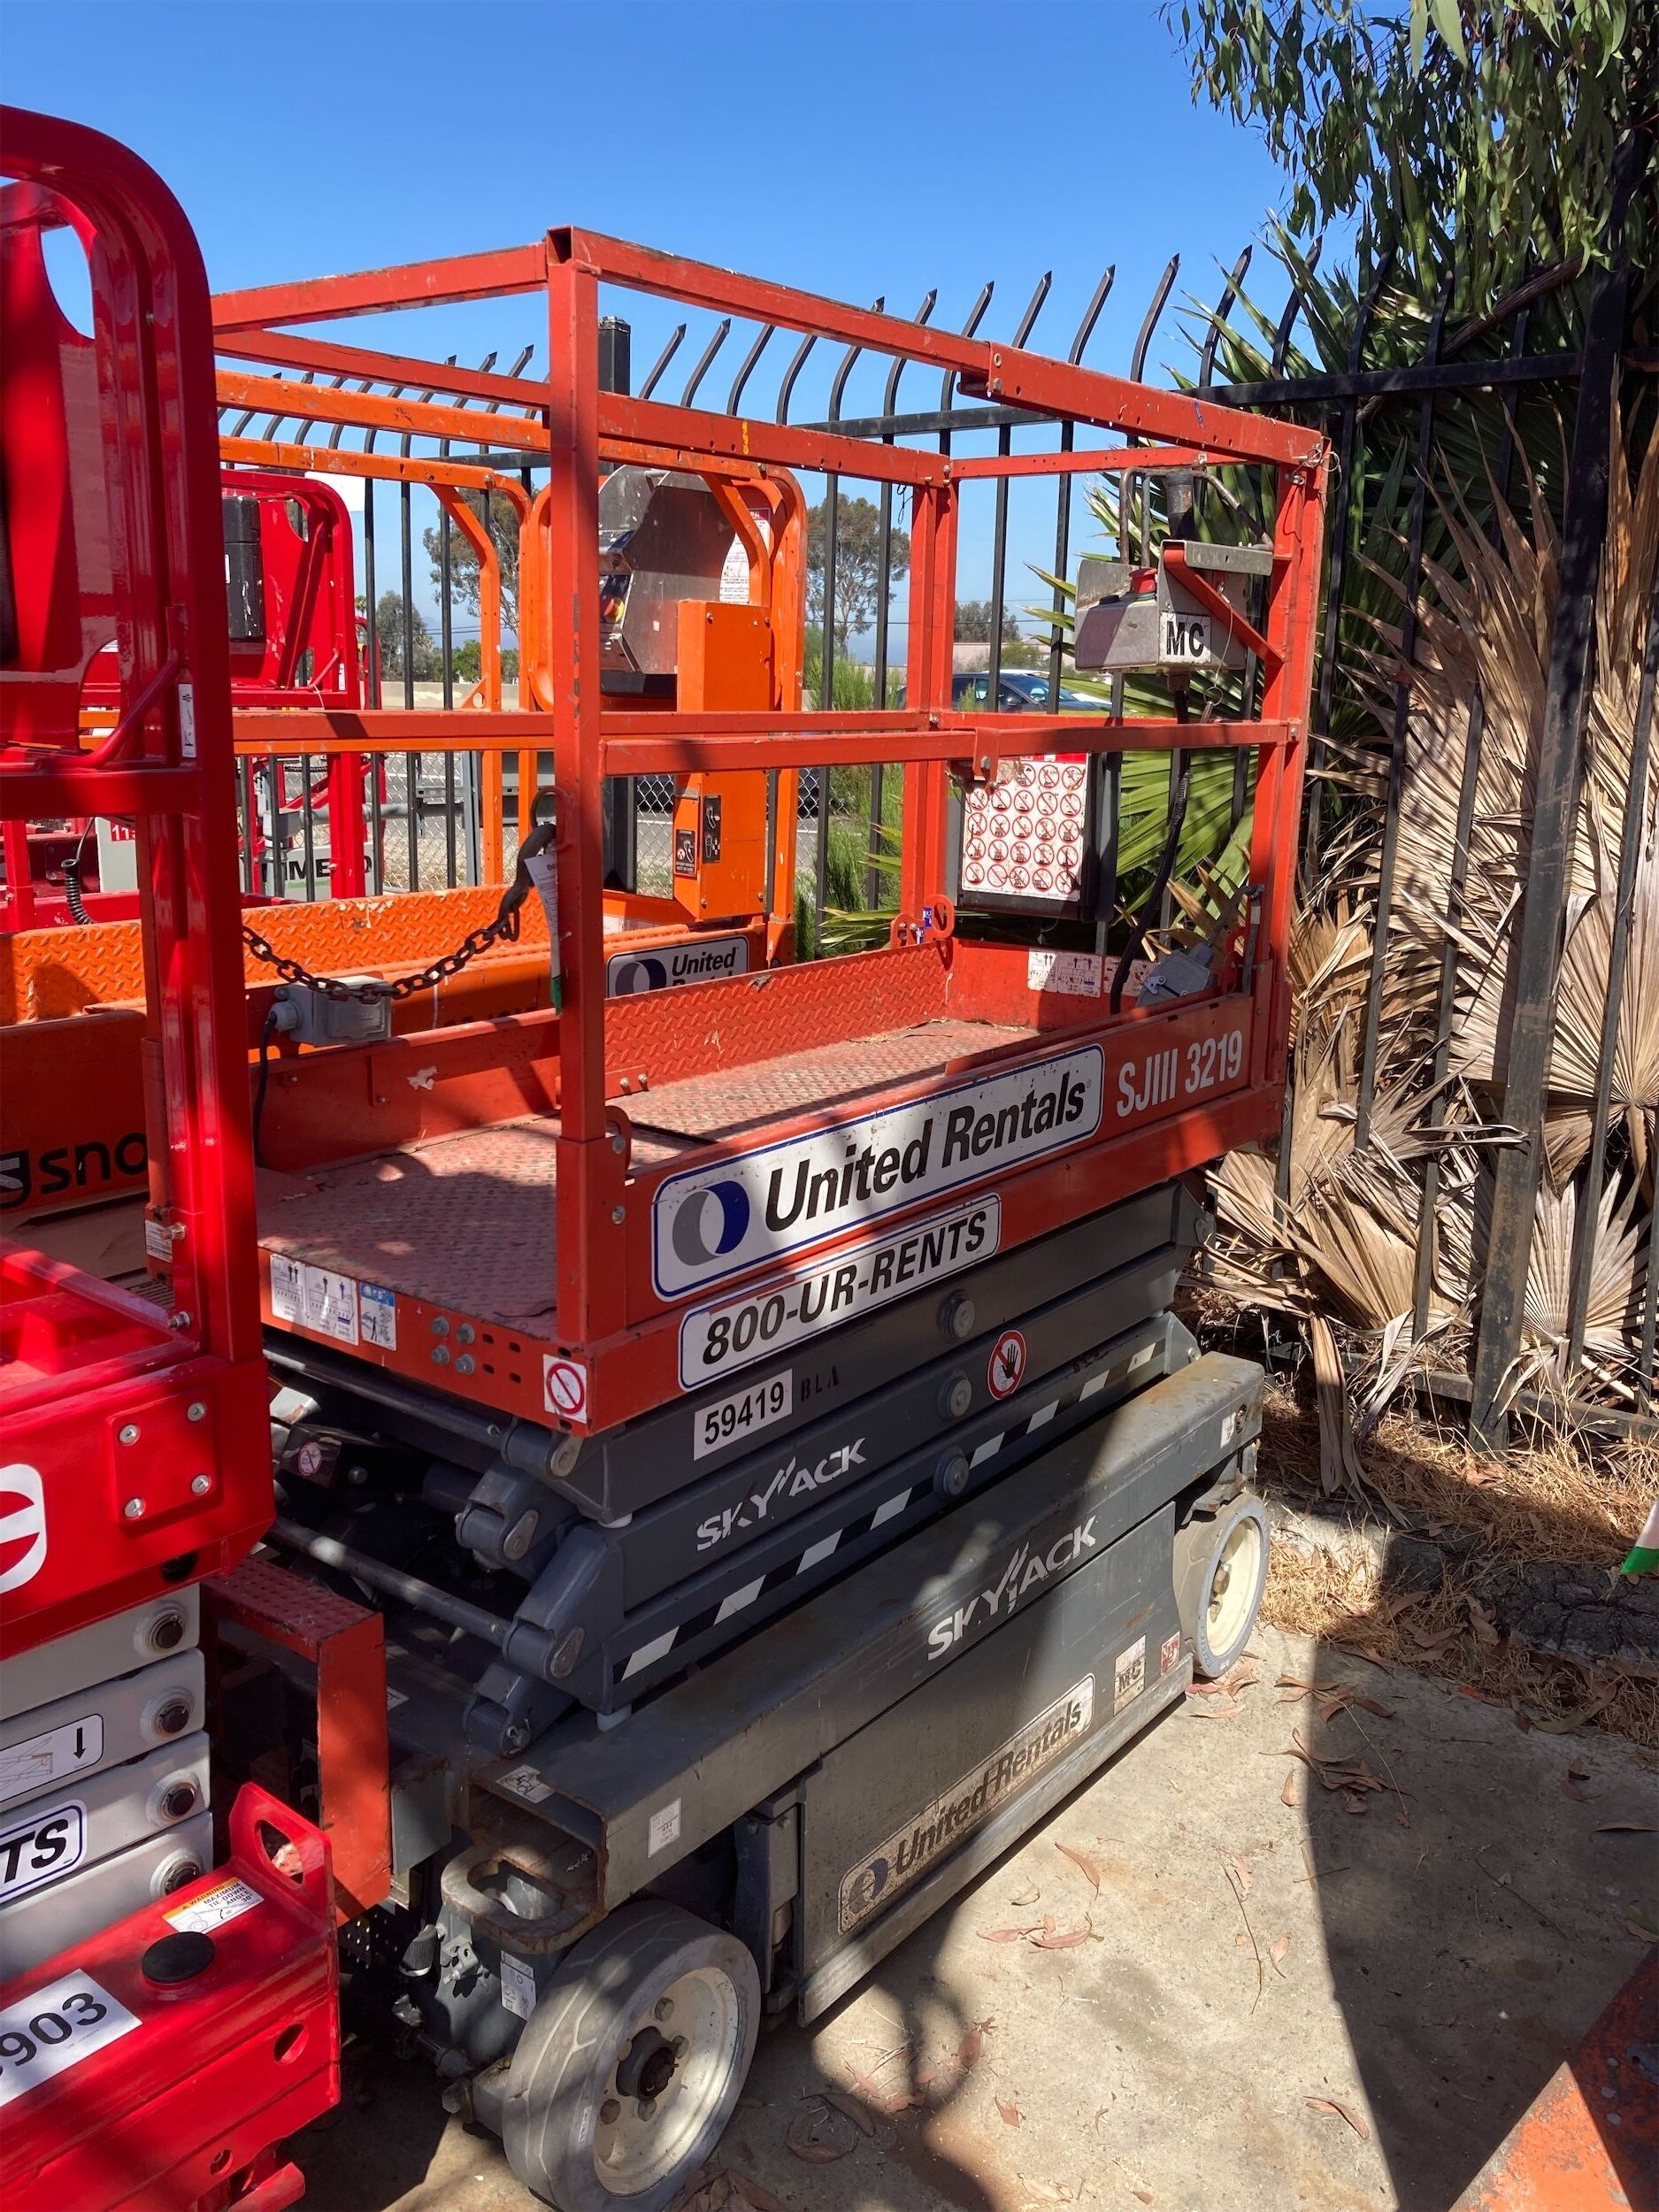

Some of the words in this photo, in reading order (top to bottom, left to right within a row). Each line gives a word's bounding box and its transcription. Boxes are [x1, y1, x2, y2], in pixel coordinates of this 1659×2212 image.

[1167, 620, 1203, 657] MC
[672, 948, 736, 976] United
[1186, 1032, 1243, 1094] 3219
[765, 1118, 933, 1233] United
[942, 1071, 1087, 1166] Rentals
[703, 1210, 987, 1365] 800-UR-RENTS
[704, 1383, 784, 1445] 59419
[697, 1438, 866, 1551] SKYJACK
[927, 1515, 1096, 1661] SKYJACK
[895, 1770, 990, 1874] United
[995, 1700, 1081, 1793] Rentals
[189, 1885, 225, 1905] WARNING
[204, 1882, 242, 1904] MAXIMUM
[209, 1886, 246, 1908] TIE-DOWN
[226, 1891, 250, 1905] ANGLE
[0, 1993, 107, 2076] 903
